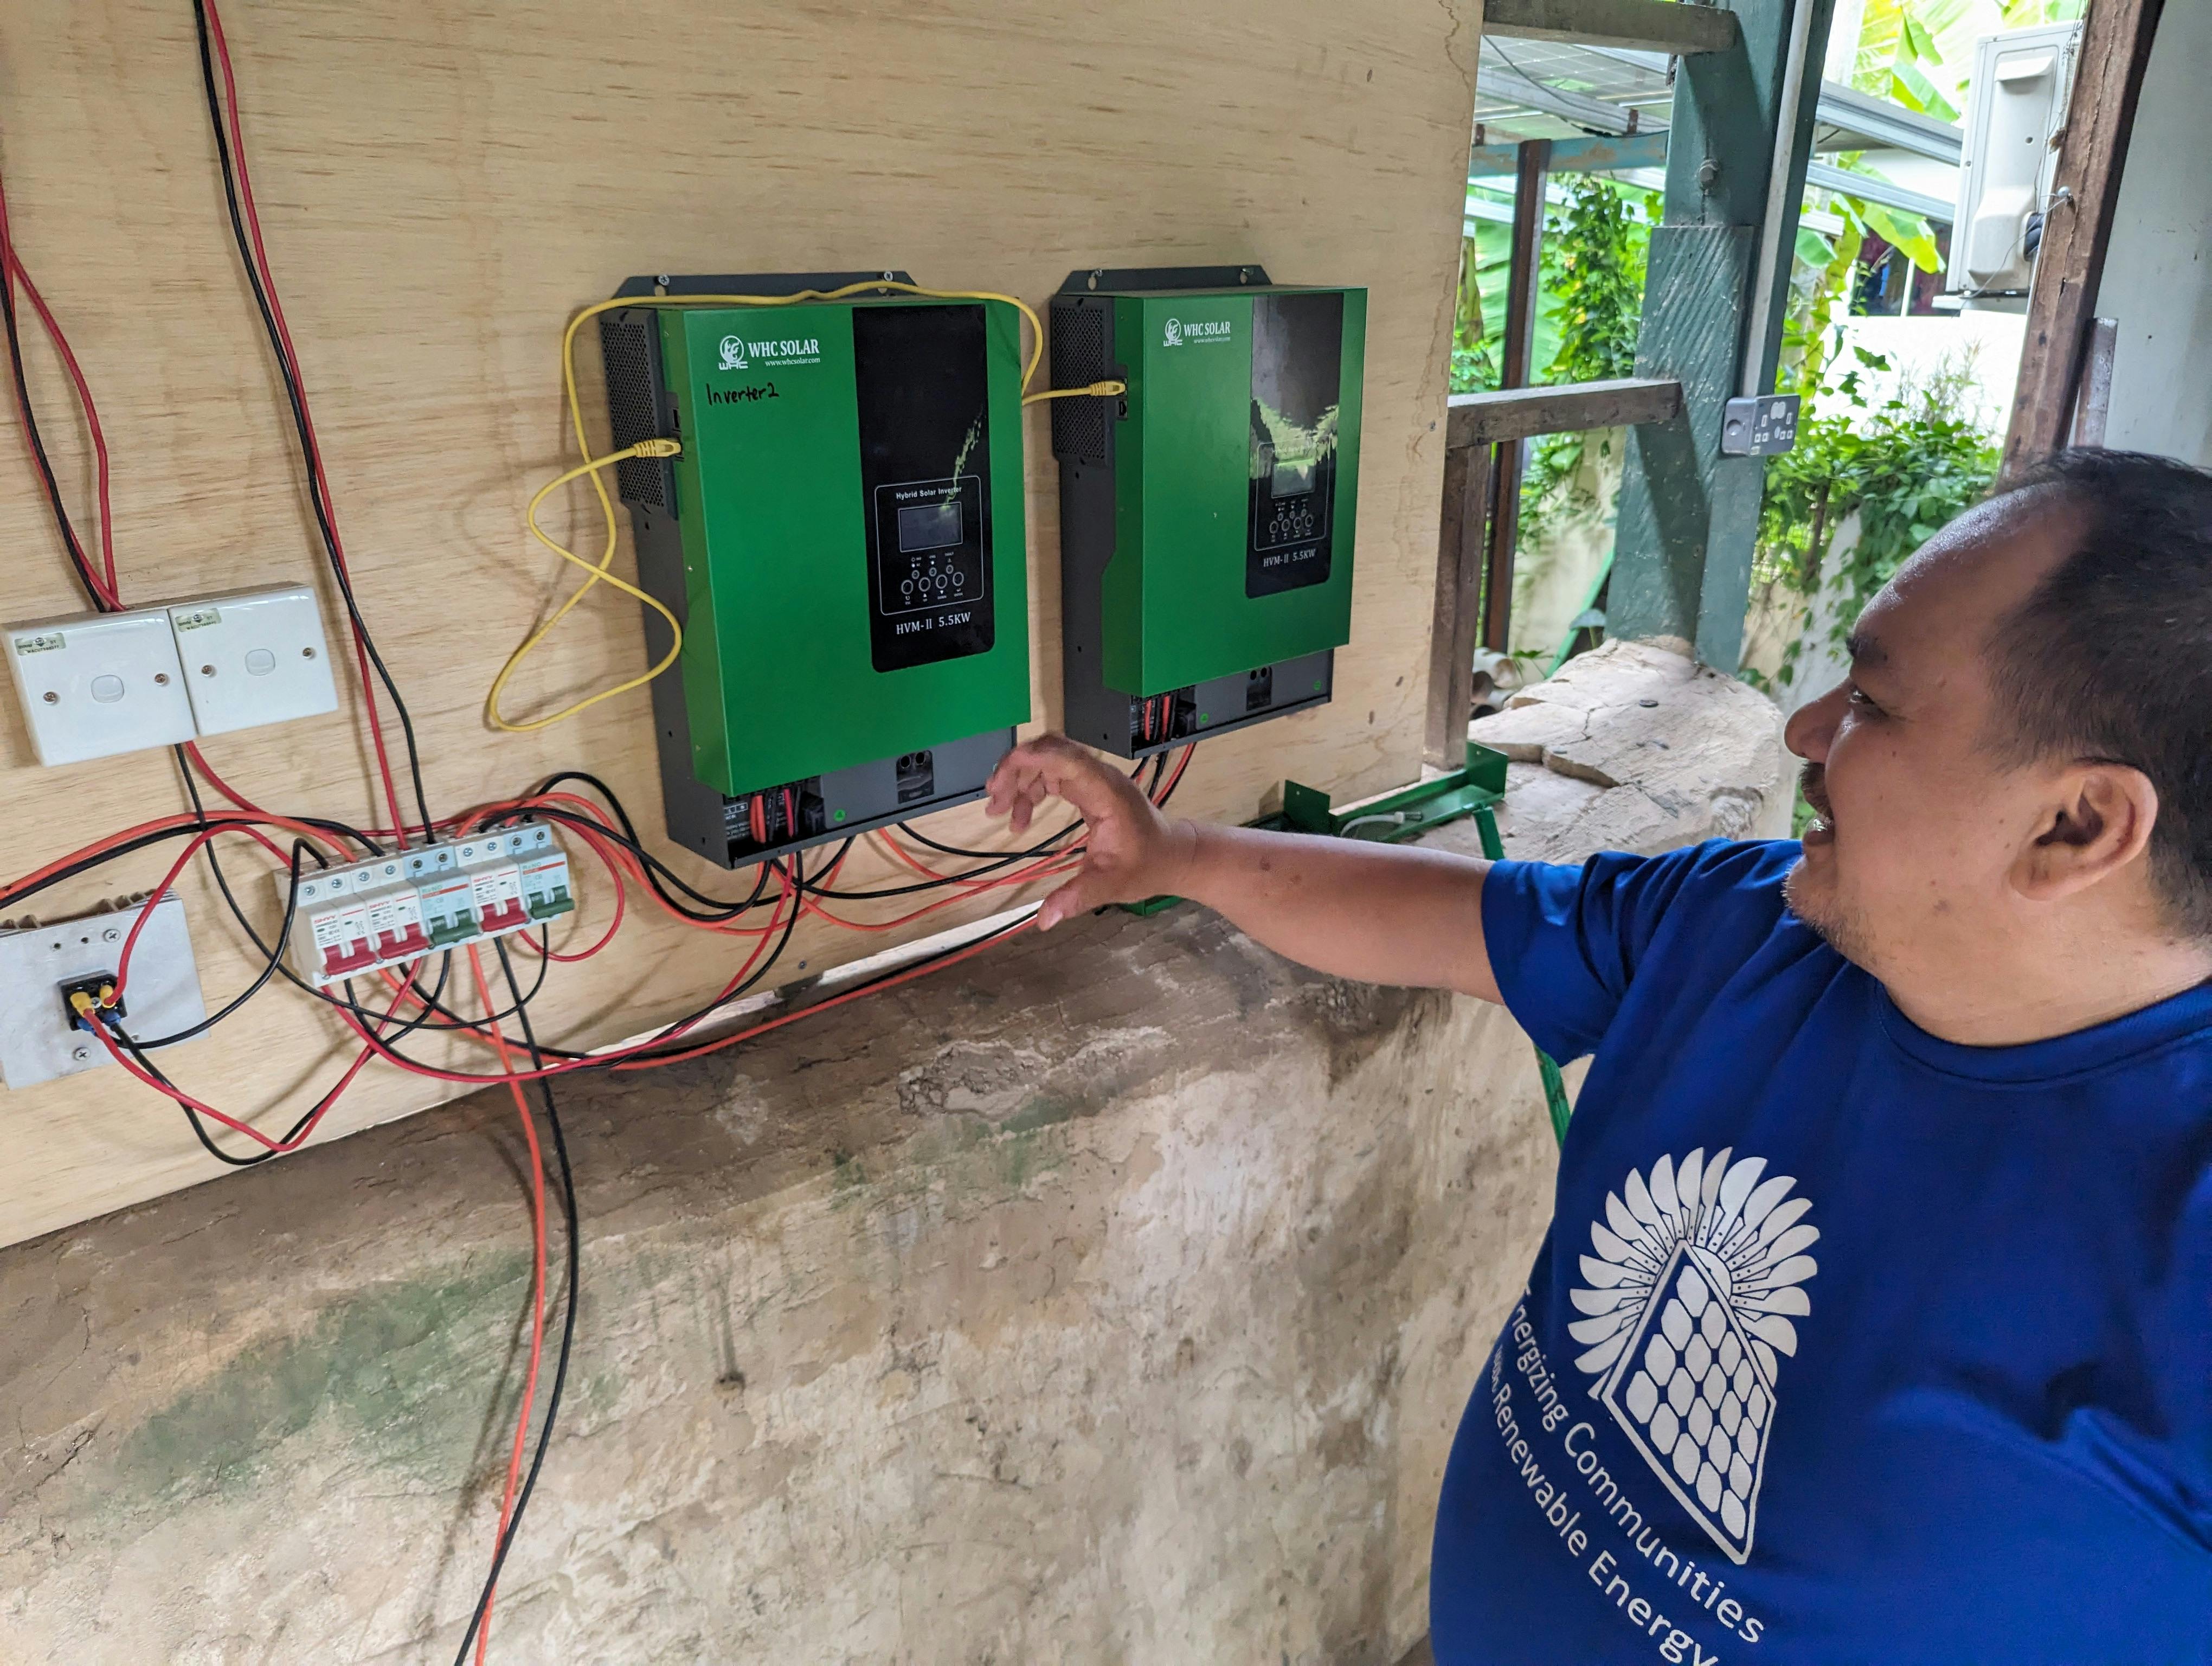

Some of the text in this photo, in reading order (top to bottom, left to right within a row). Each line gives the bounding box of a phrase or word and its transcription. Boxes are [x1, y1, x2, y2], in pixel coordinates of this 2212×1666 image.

[1184, 321, 1231, 337] WHC SOLAR
[748, 339, 820, 358] WHC SOLAR
[765, 357, 820, 367] www.whcsolar.com
[896, 486, 962, 501] Hybrid Solar Inverter
[1263, 549, 1316, 567] HVM-II 5.5KW
[896, 612, 971, 635] HVM-II 5.5KW
[1493, 1383, 1587, 1556] Renewable
[1565, 1422, 1764, 1643] Communities
